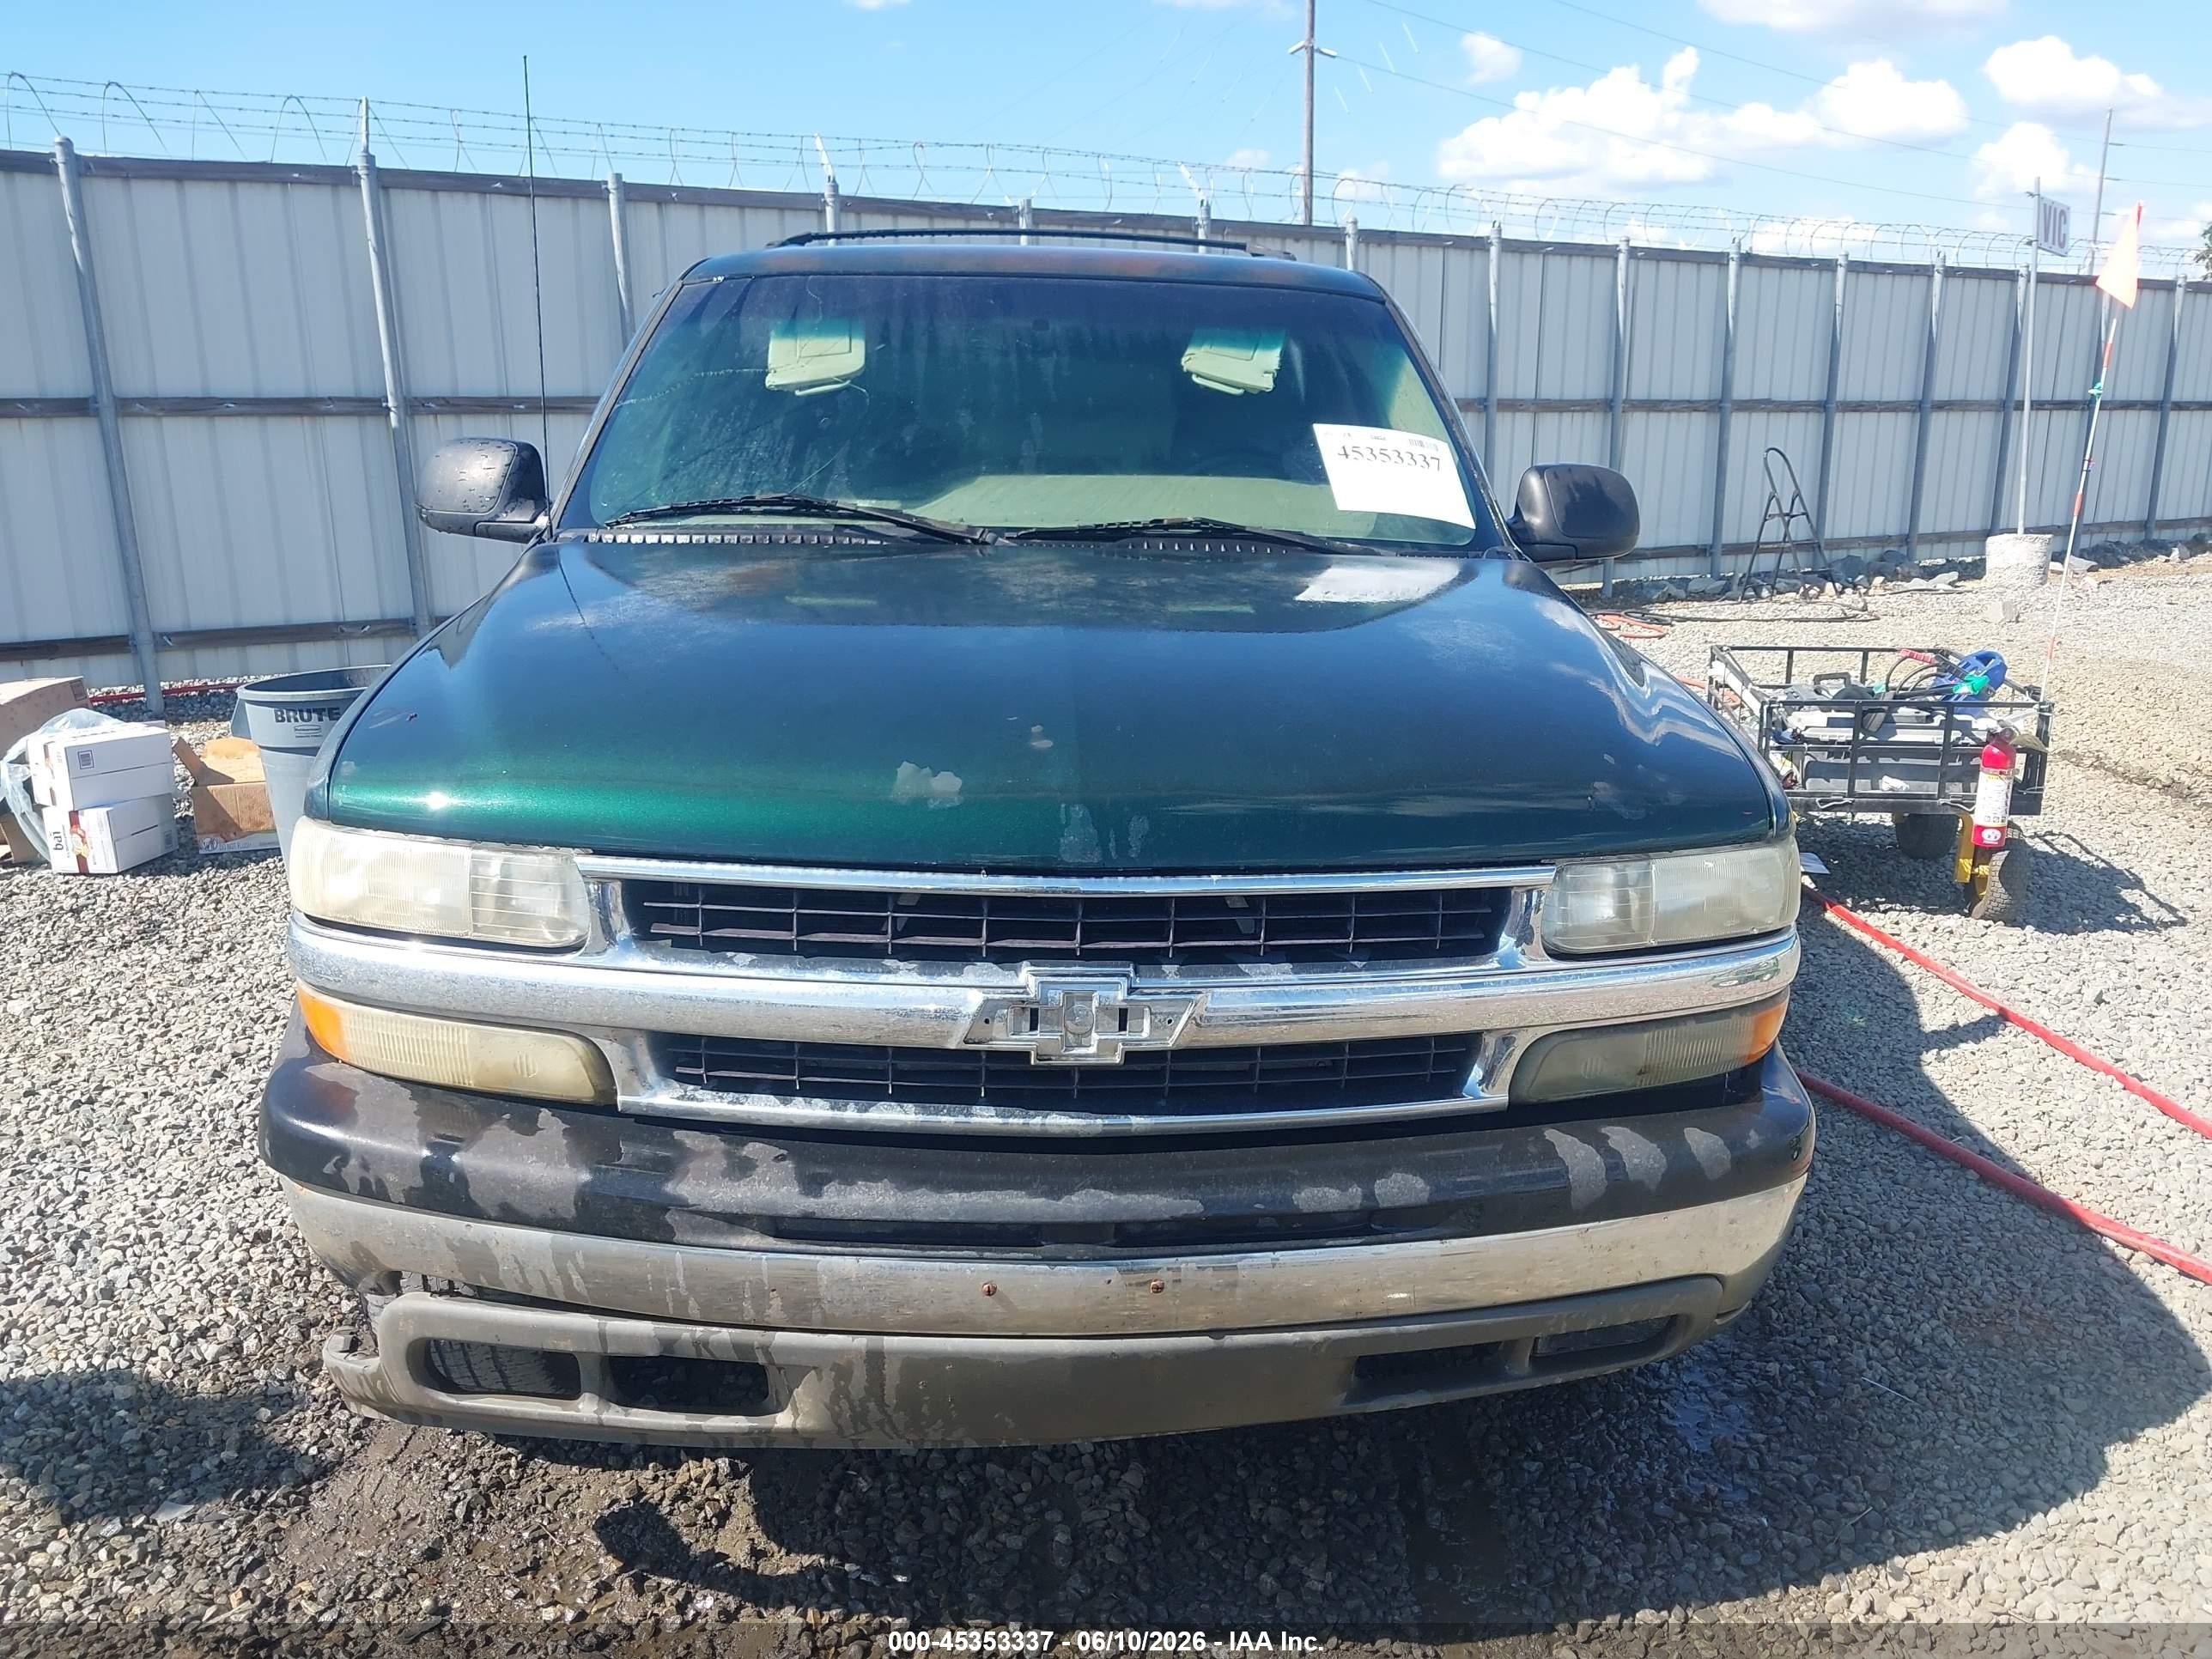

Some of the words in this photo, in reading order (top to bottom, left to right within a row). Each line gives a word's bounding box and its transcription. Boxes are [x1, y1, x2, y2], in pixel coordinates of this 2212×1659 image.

[2043, 203, 2067, 249] VIC
[1338, 445, 1441, 471] 45353337
[274, 707, 341, 723] BRUTE
